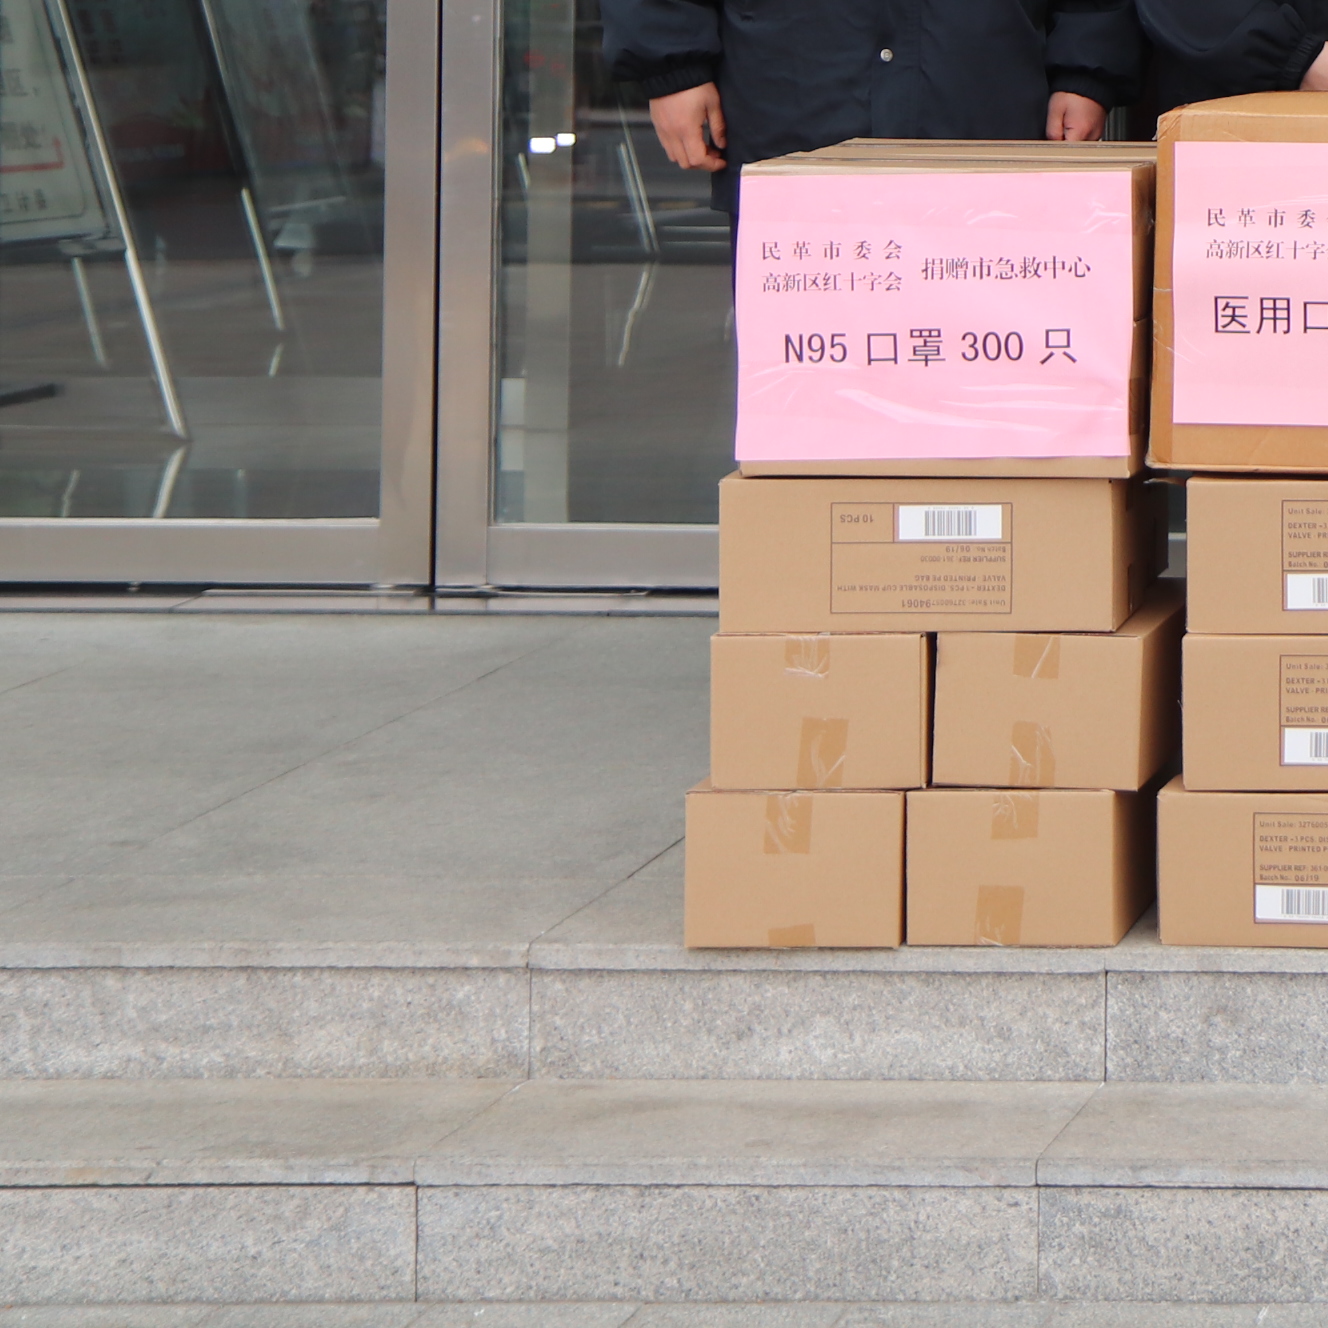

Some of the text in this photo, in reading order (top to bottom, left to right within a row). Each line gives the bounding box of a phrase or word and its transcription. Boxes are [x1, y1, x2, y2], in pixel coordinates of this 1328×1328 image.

[762, 239, 903, 261] 民革市委会
[920, 256, 1092, 280] 捐赠市急救中心
[762, 272, 903, 293] 高新区红十字会
[785, 328, 1078, 368] N95 口罩 300 只
[840, 514, 874, 523] 10 PCS
